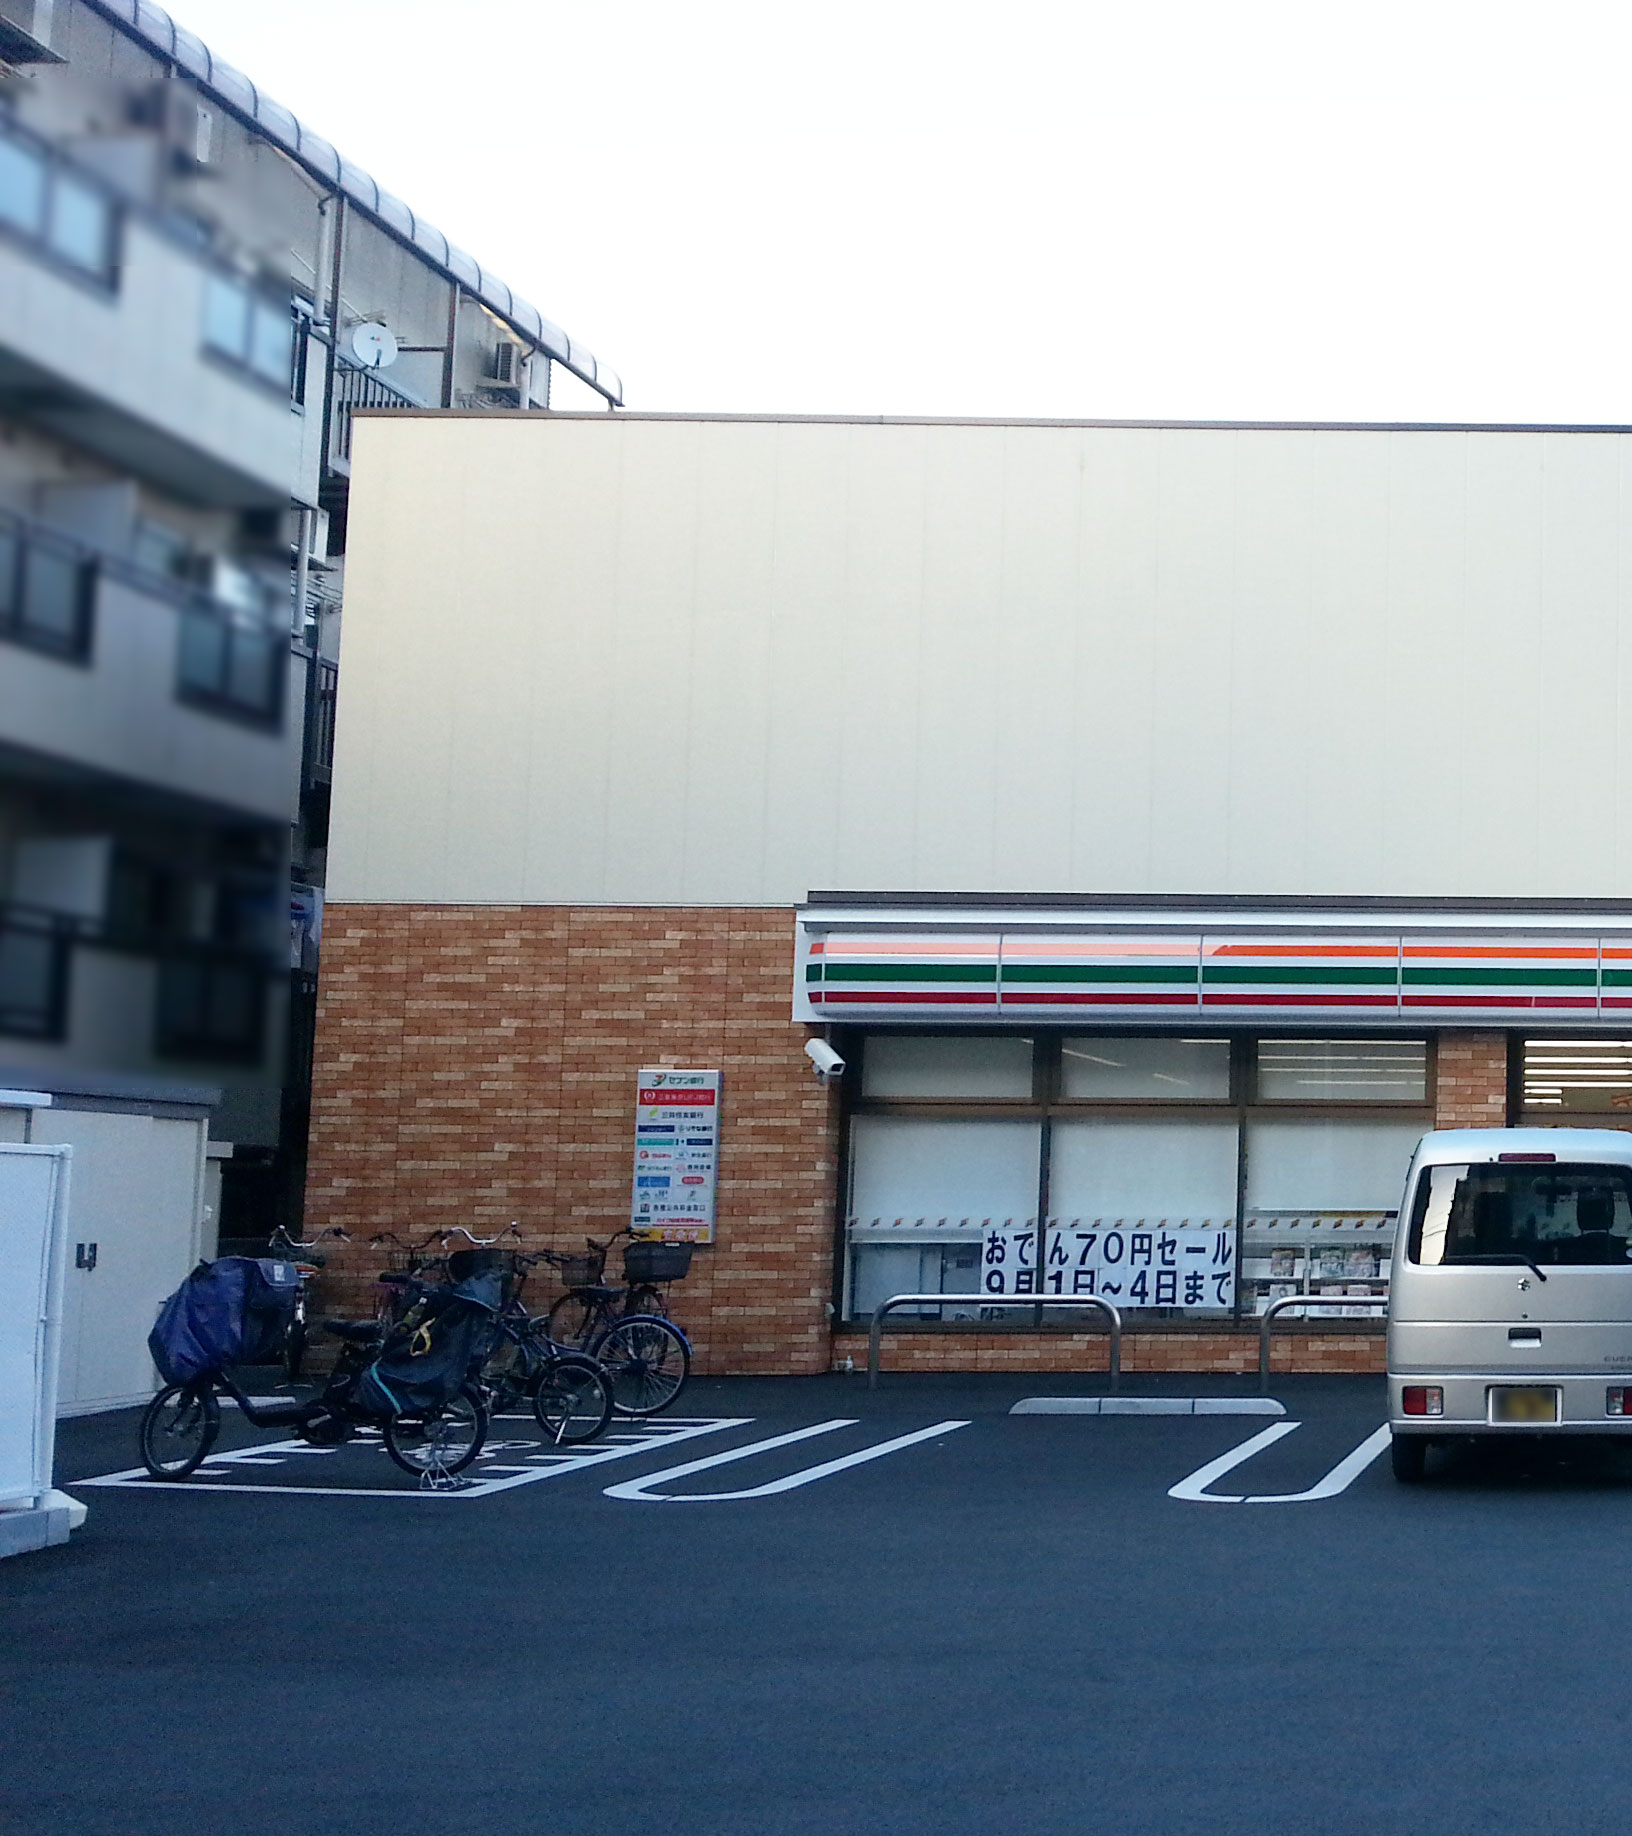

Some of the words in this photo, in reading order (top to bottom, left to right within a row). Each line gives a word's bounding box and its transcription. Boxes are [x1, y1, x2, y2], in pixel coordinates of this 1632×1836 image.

[985, 1230, 1233, 1266] おでん70円セール
